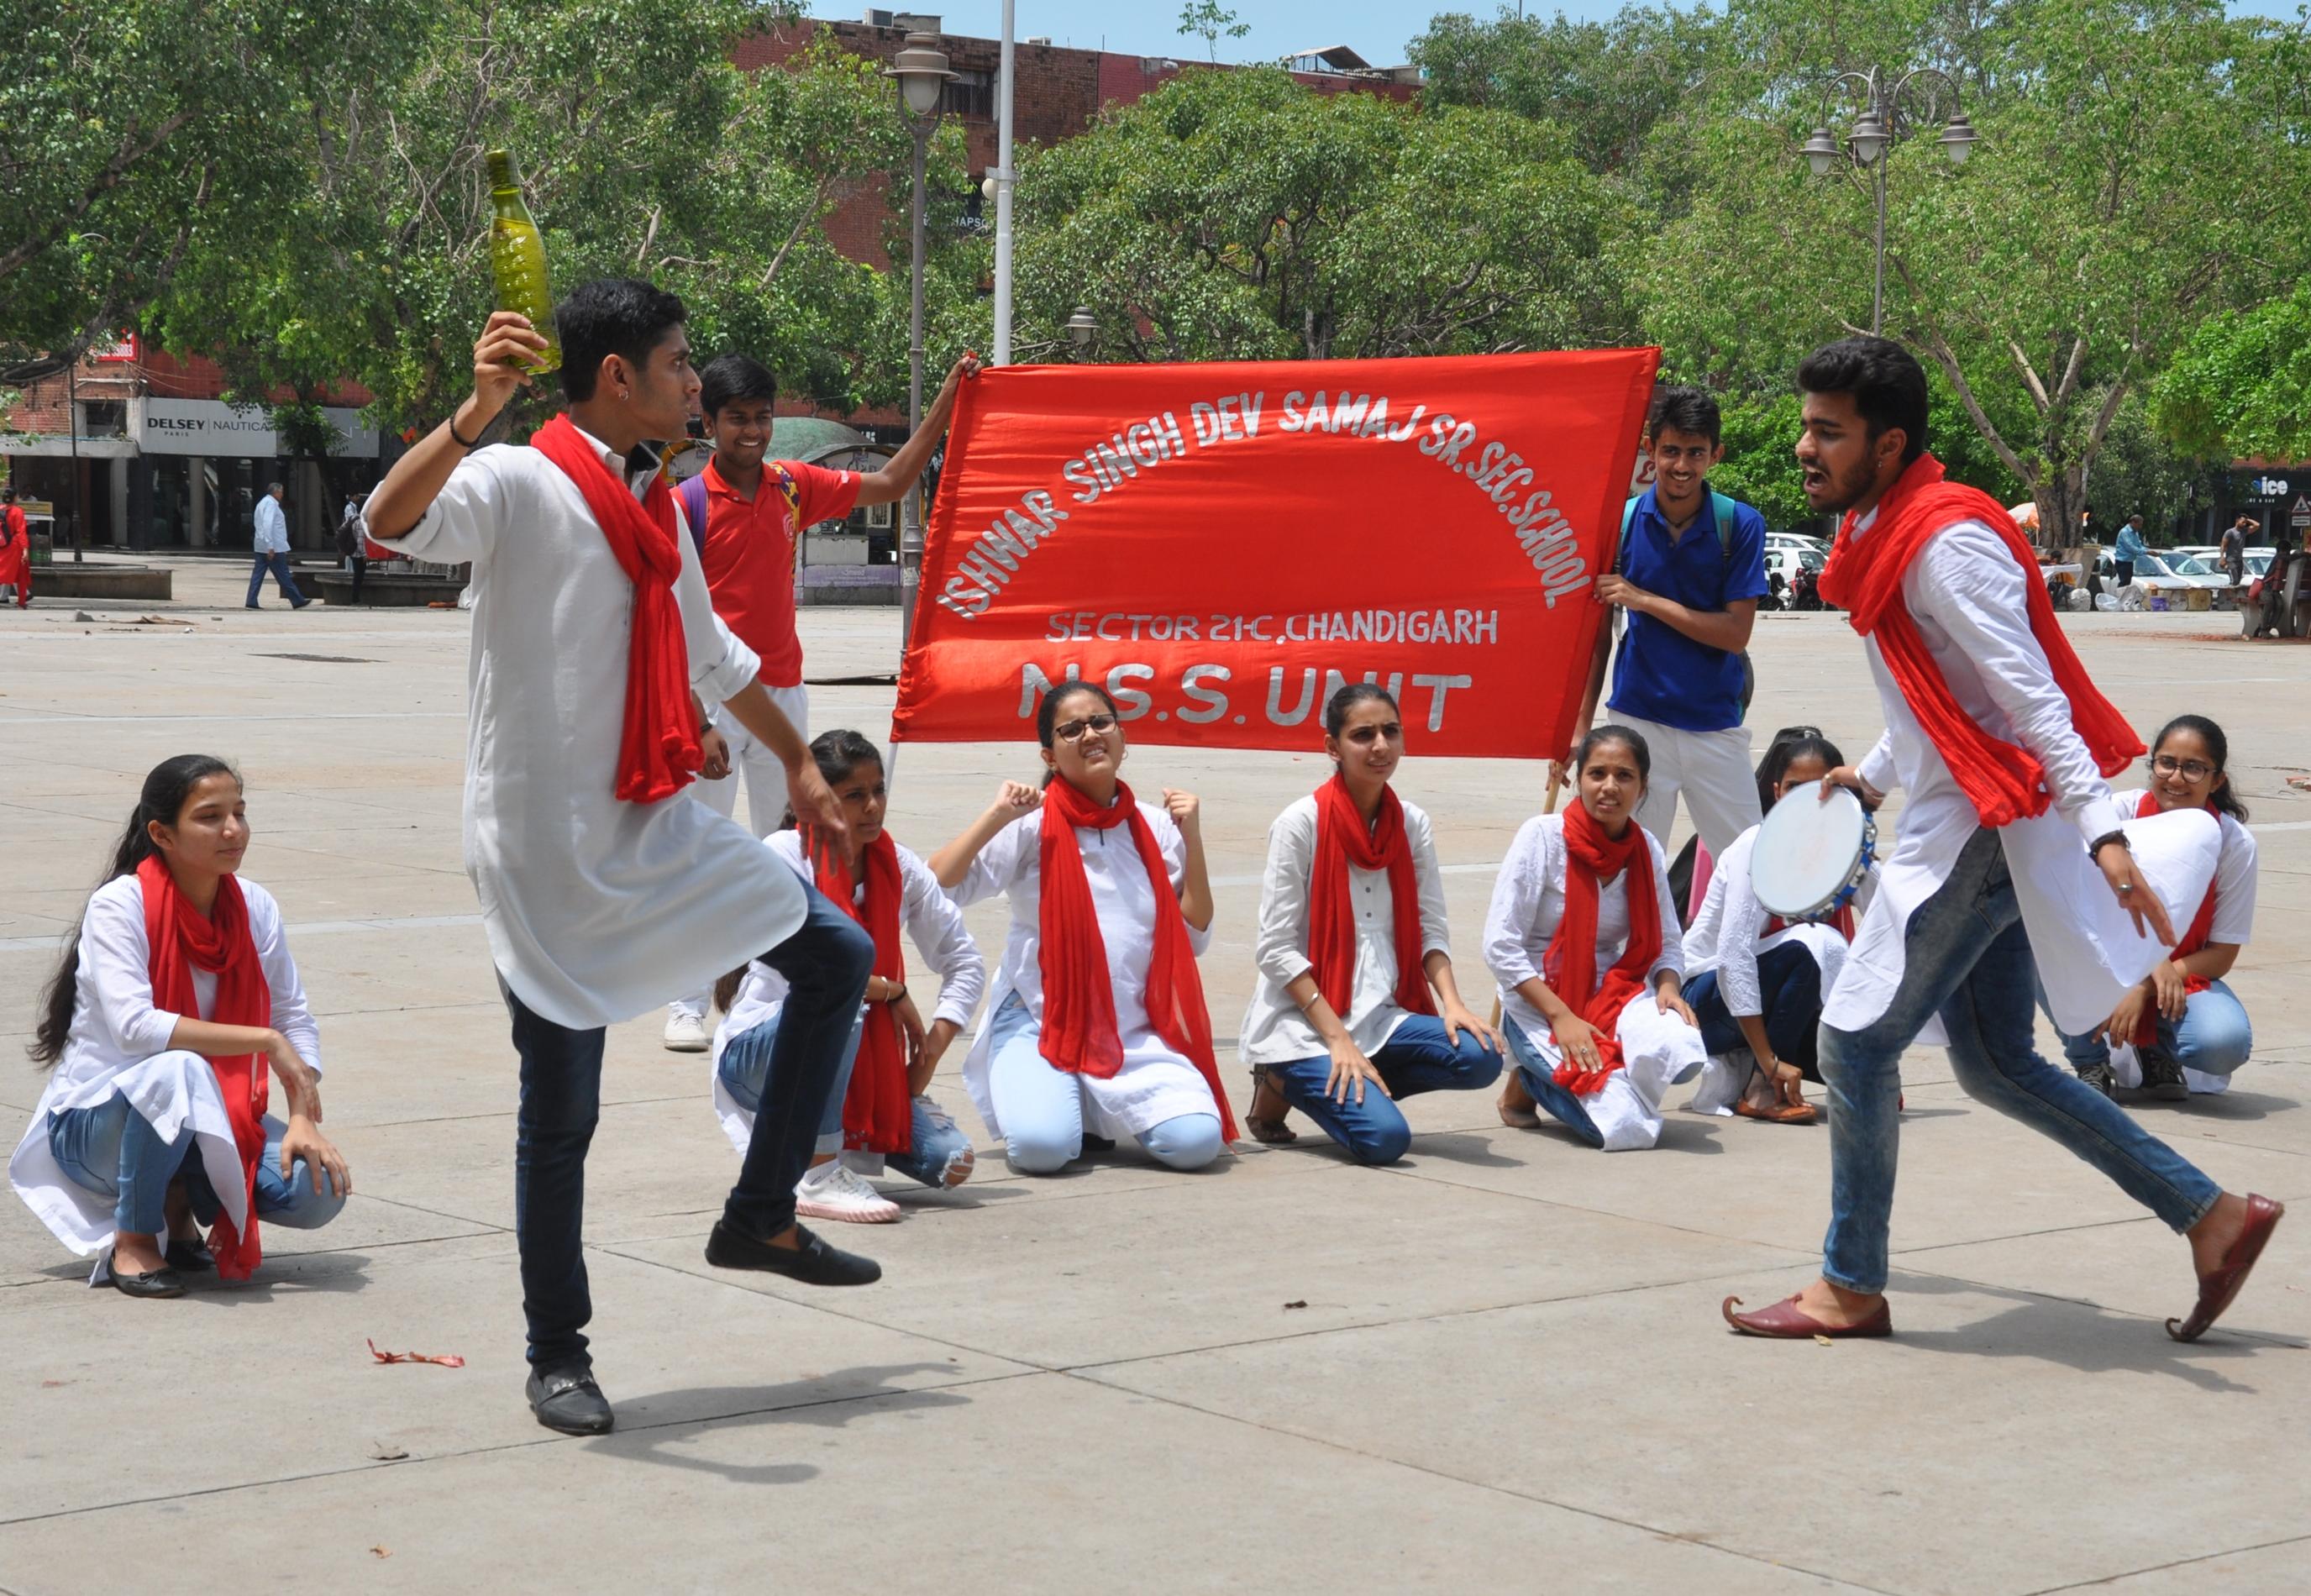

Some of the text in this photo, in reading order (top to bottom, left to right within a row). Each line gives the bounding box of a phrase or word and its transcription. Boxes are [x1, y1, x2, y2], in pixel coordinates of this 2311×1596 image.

[147, 417, 269, 432] DELSEY NAUTICA
[936, 490, 1069, 620] ISHWAR
[1064, 412, 1185, 503] SINGH
[1190, 391, 1263, 447] DEV
[1278, 391, 1426, 442] SAMAJ
[1045, 612, 1200, 642] SECTOR
